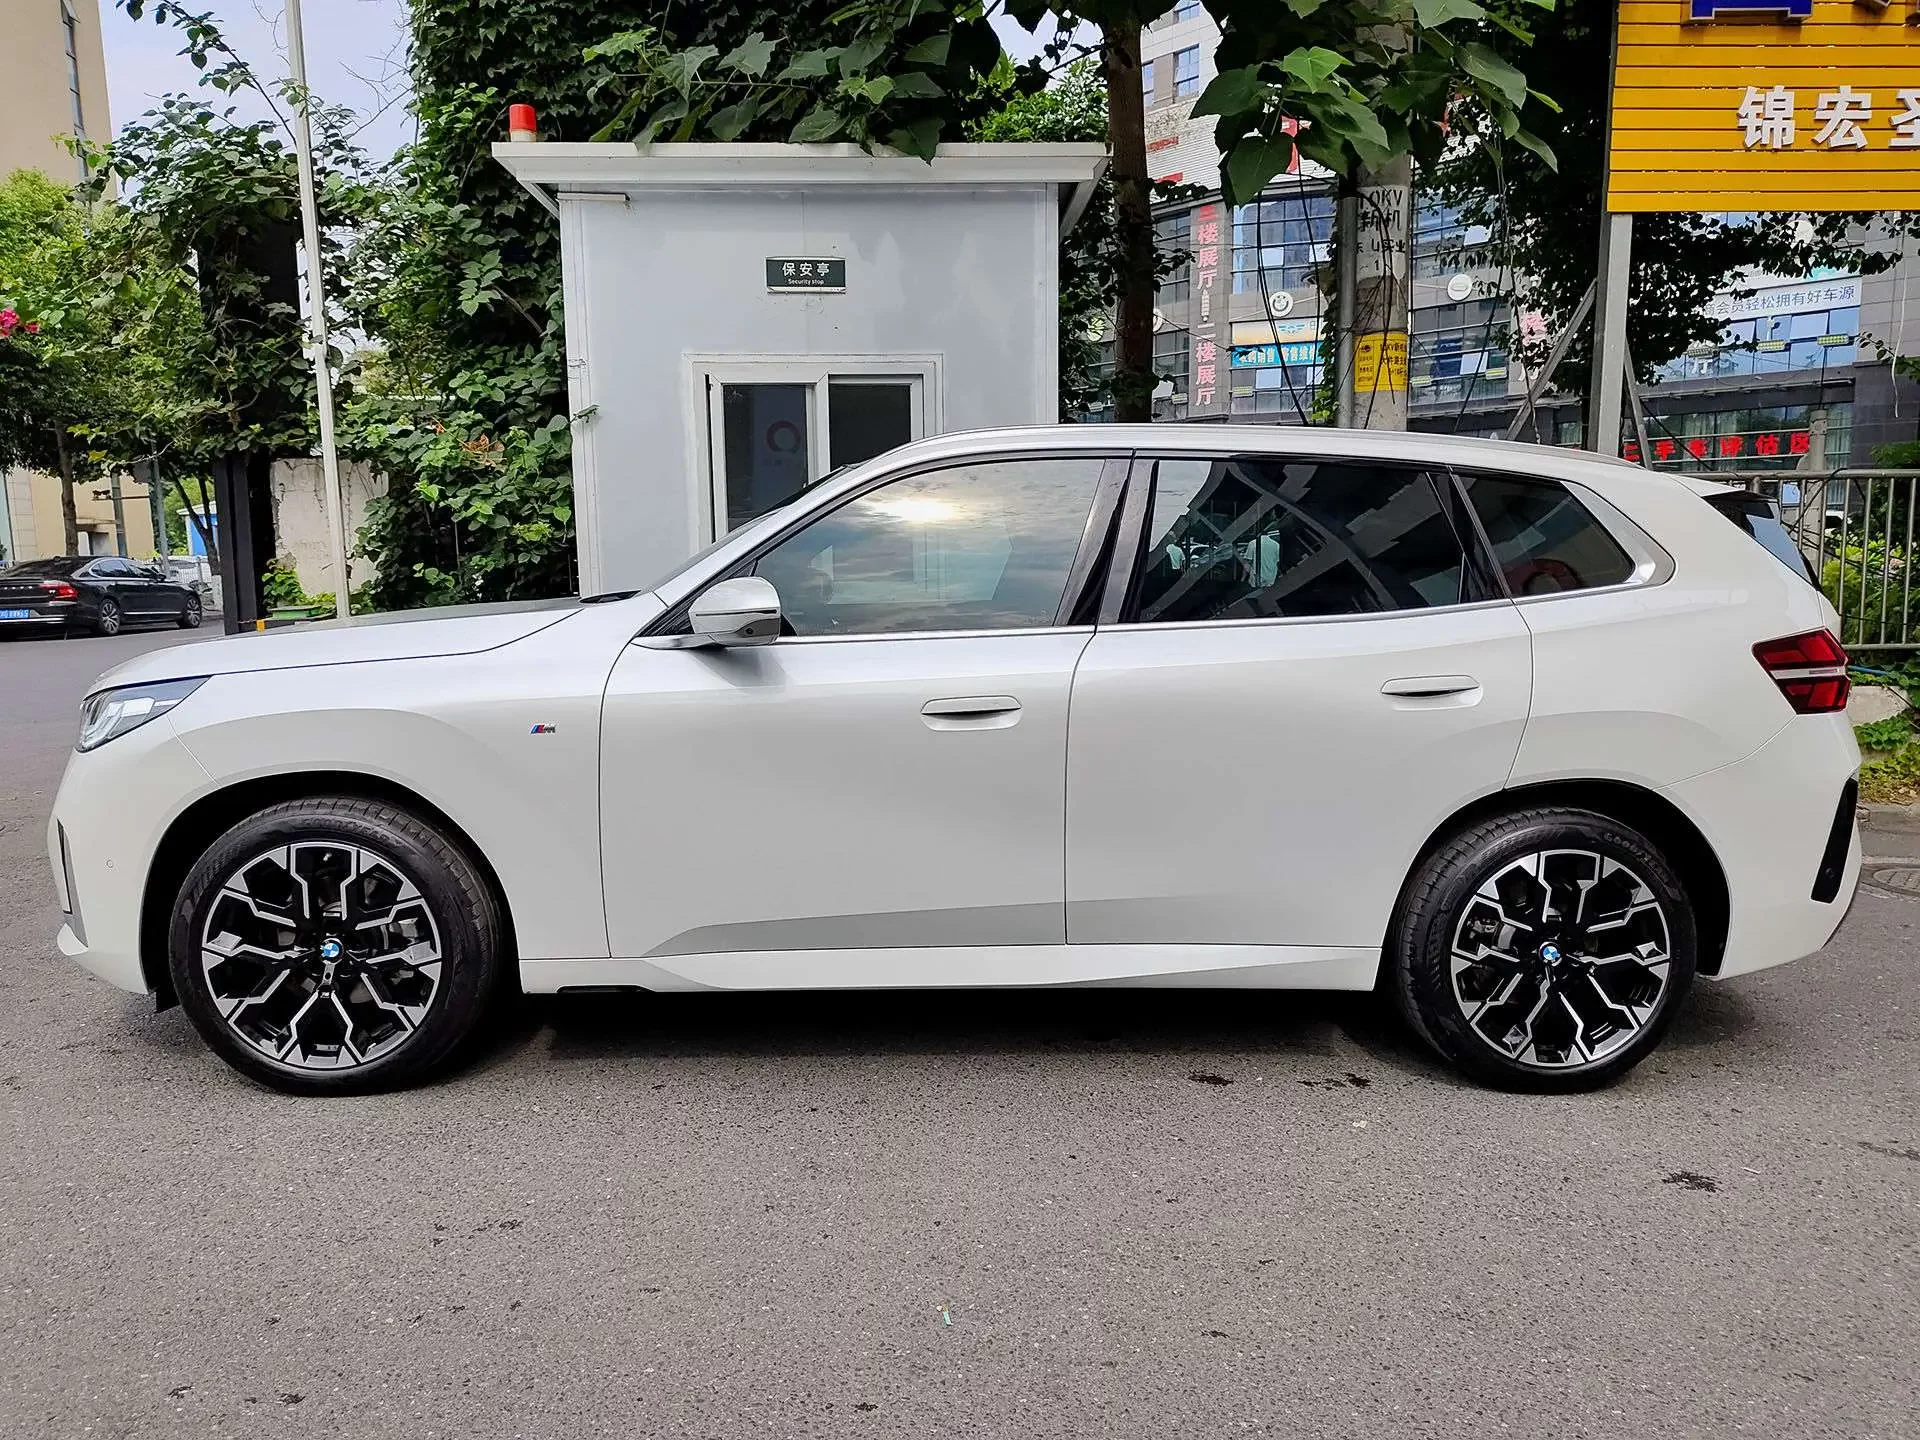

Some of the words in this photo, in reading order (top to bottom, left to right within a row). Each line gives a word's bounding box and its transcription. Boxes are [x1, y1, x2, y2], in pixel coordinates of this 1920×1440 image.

[781, 262, 829, 276] 保安亭
[1197, 204, 1219, 289] 三楼展厅
[1195, 322, 1217, 405] 二楼展厅
